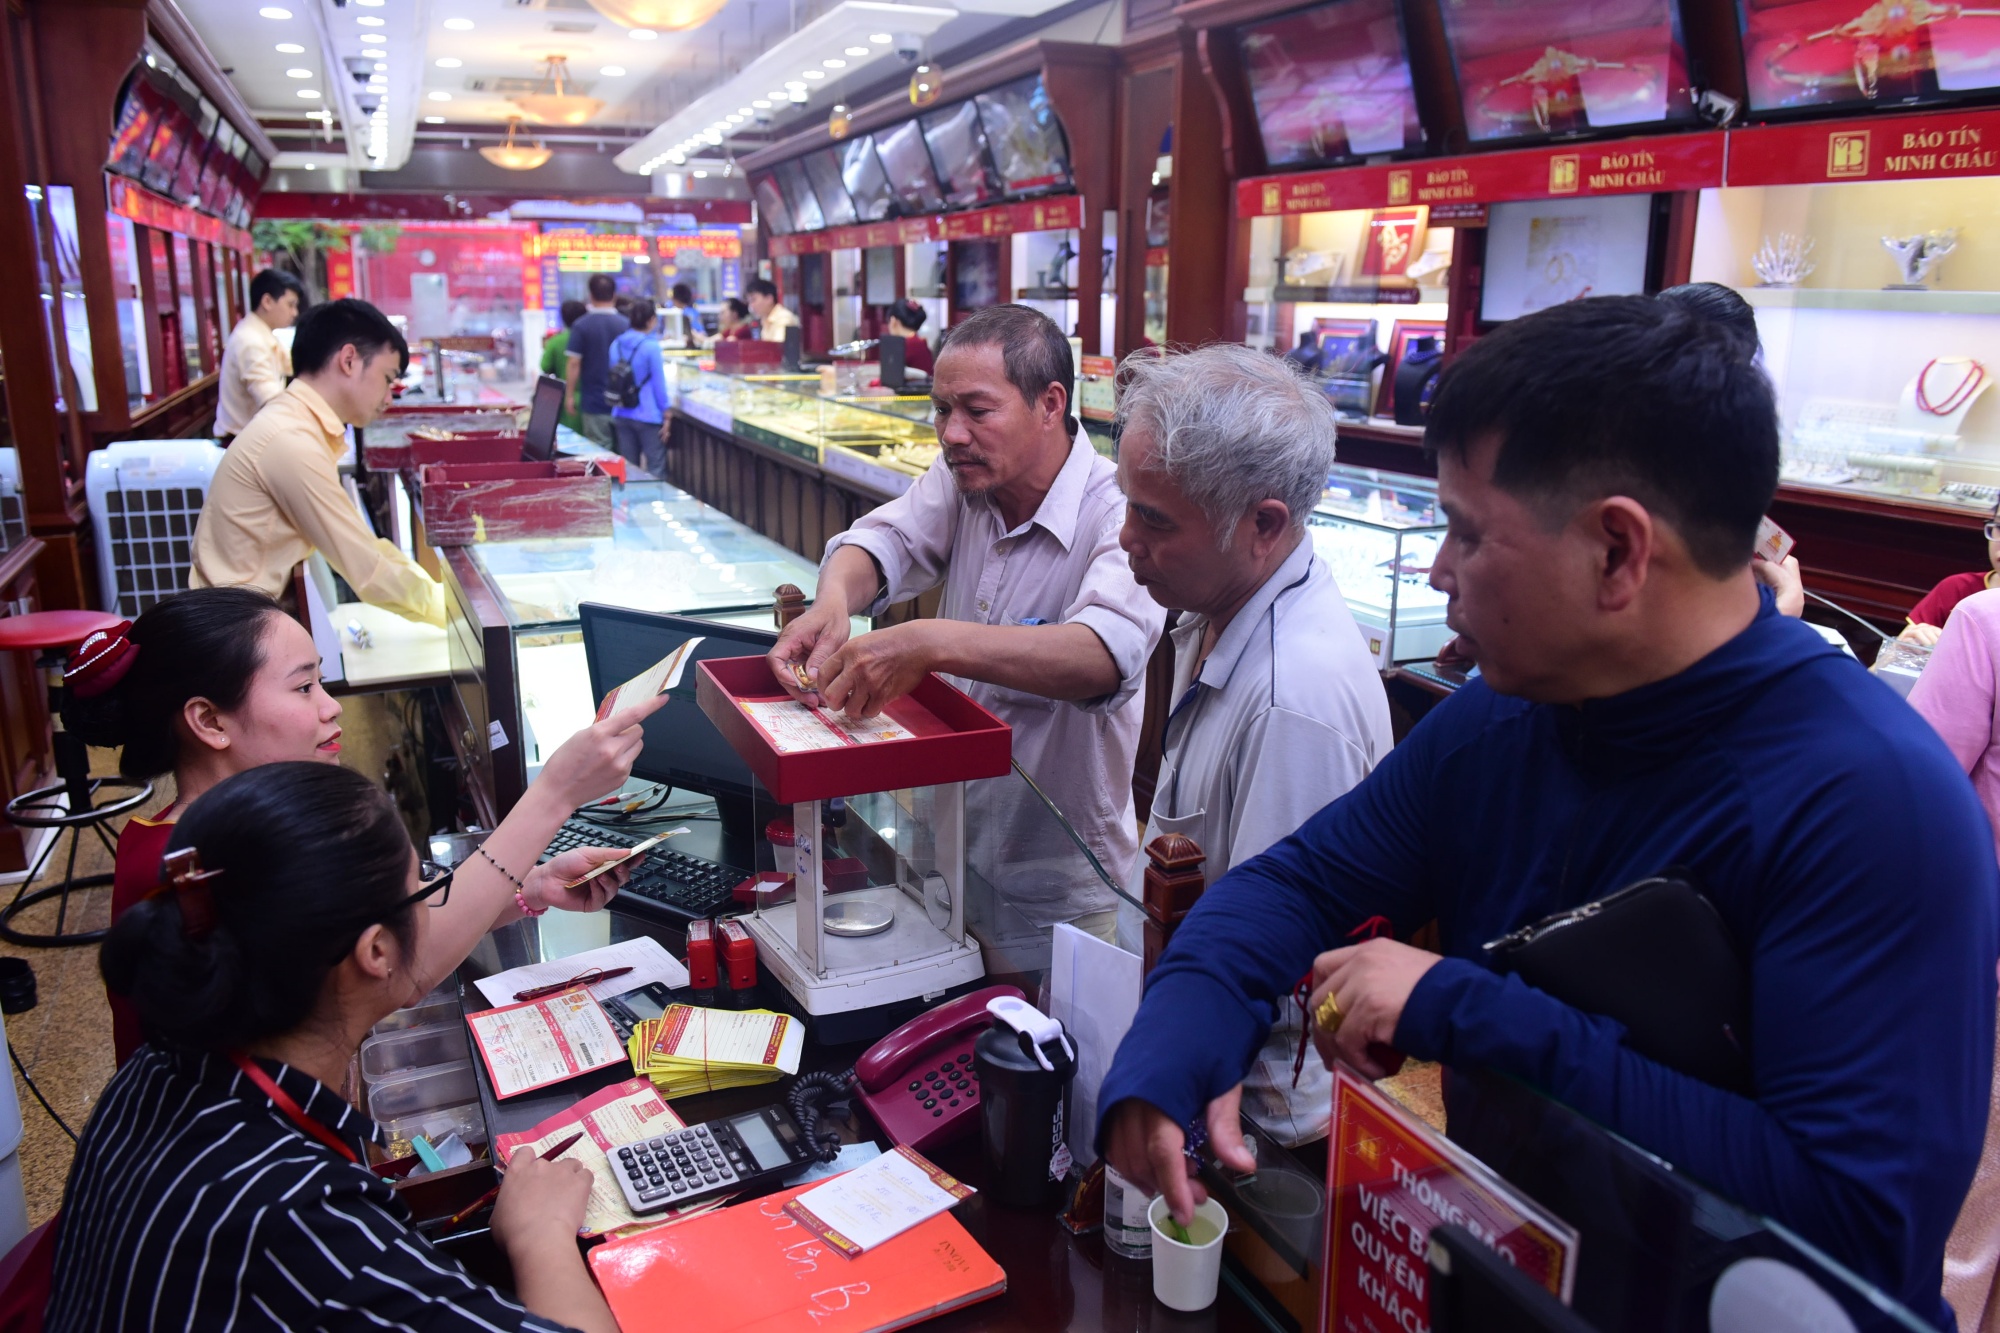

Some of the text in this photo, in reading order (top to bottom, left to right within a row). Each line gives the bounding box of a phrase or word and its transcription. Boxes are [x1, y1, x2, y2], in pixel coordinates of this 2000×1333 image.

[1902, 125, 1982, 149] BẢO TÍN
[1632, 149, 1655, 168] TÍN
[1884, 147, 1997, 172] MINH CHÂU
[1589, 168, 1666, 188] MINH CHÂU
[769, 1109, 780, 1121] CASIO
[1390, 1157, 1464, 1225] THÔNG
[1358, 1183, 1406, 1243] VIỆC
